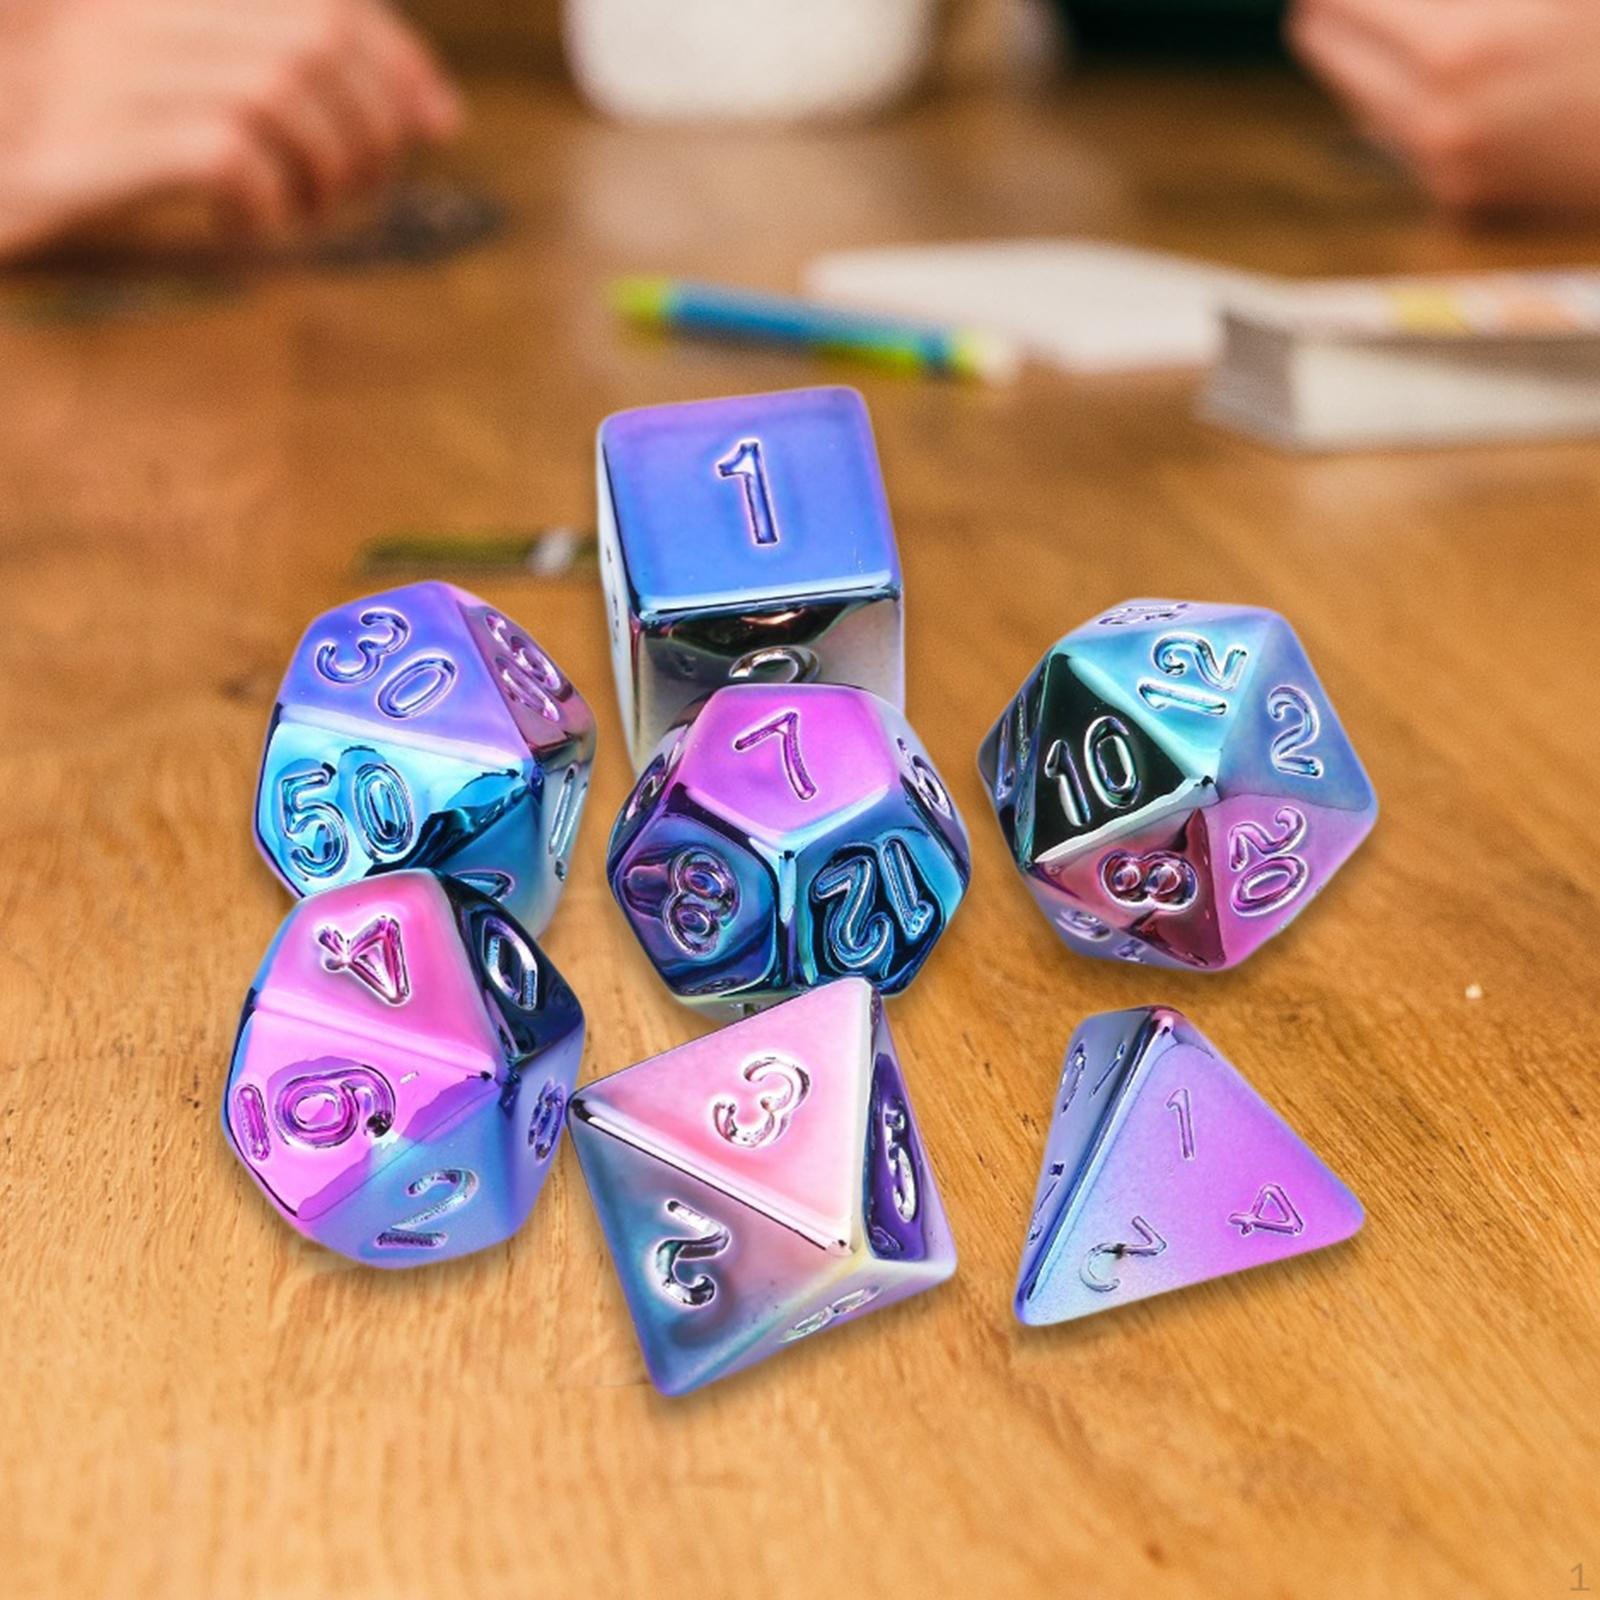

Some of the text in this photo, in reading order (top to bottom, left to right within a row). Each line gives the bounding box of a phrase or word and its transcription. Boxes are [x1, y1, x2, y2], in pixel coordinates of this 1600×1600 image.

[716, 438, 779, 546] 1
[316, 606, 458, 719] 30
[1136, 630, 1249, 718] 12
[732, 711, 819, 801] 7
[1043, 714, 1143, 827] 10
[1266, 684, 1325, 779] 2
[278, 762, 415, 880] 50
[1228, 806, 1310, 917] 20
[663, 848, 738, 956] 8
[814, 838, 935, 972] 12
[1100, 849, 1199, 915] 8
[317, 914, 412, 1006] 4
[482, 916, 538, 1011] 0
[711, 1054, 811, 1148] 3
[1166, 1088, 1195, 1161] 1
[374, 1168, 481, 1249] 2
[654, 1198, 732, 1308] 2
[1078, 1214, 1168, 1292] 2
[1227, 1183, 1304, 1236] 4
